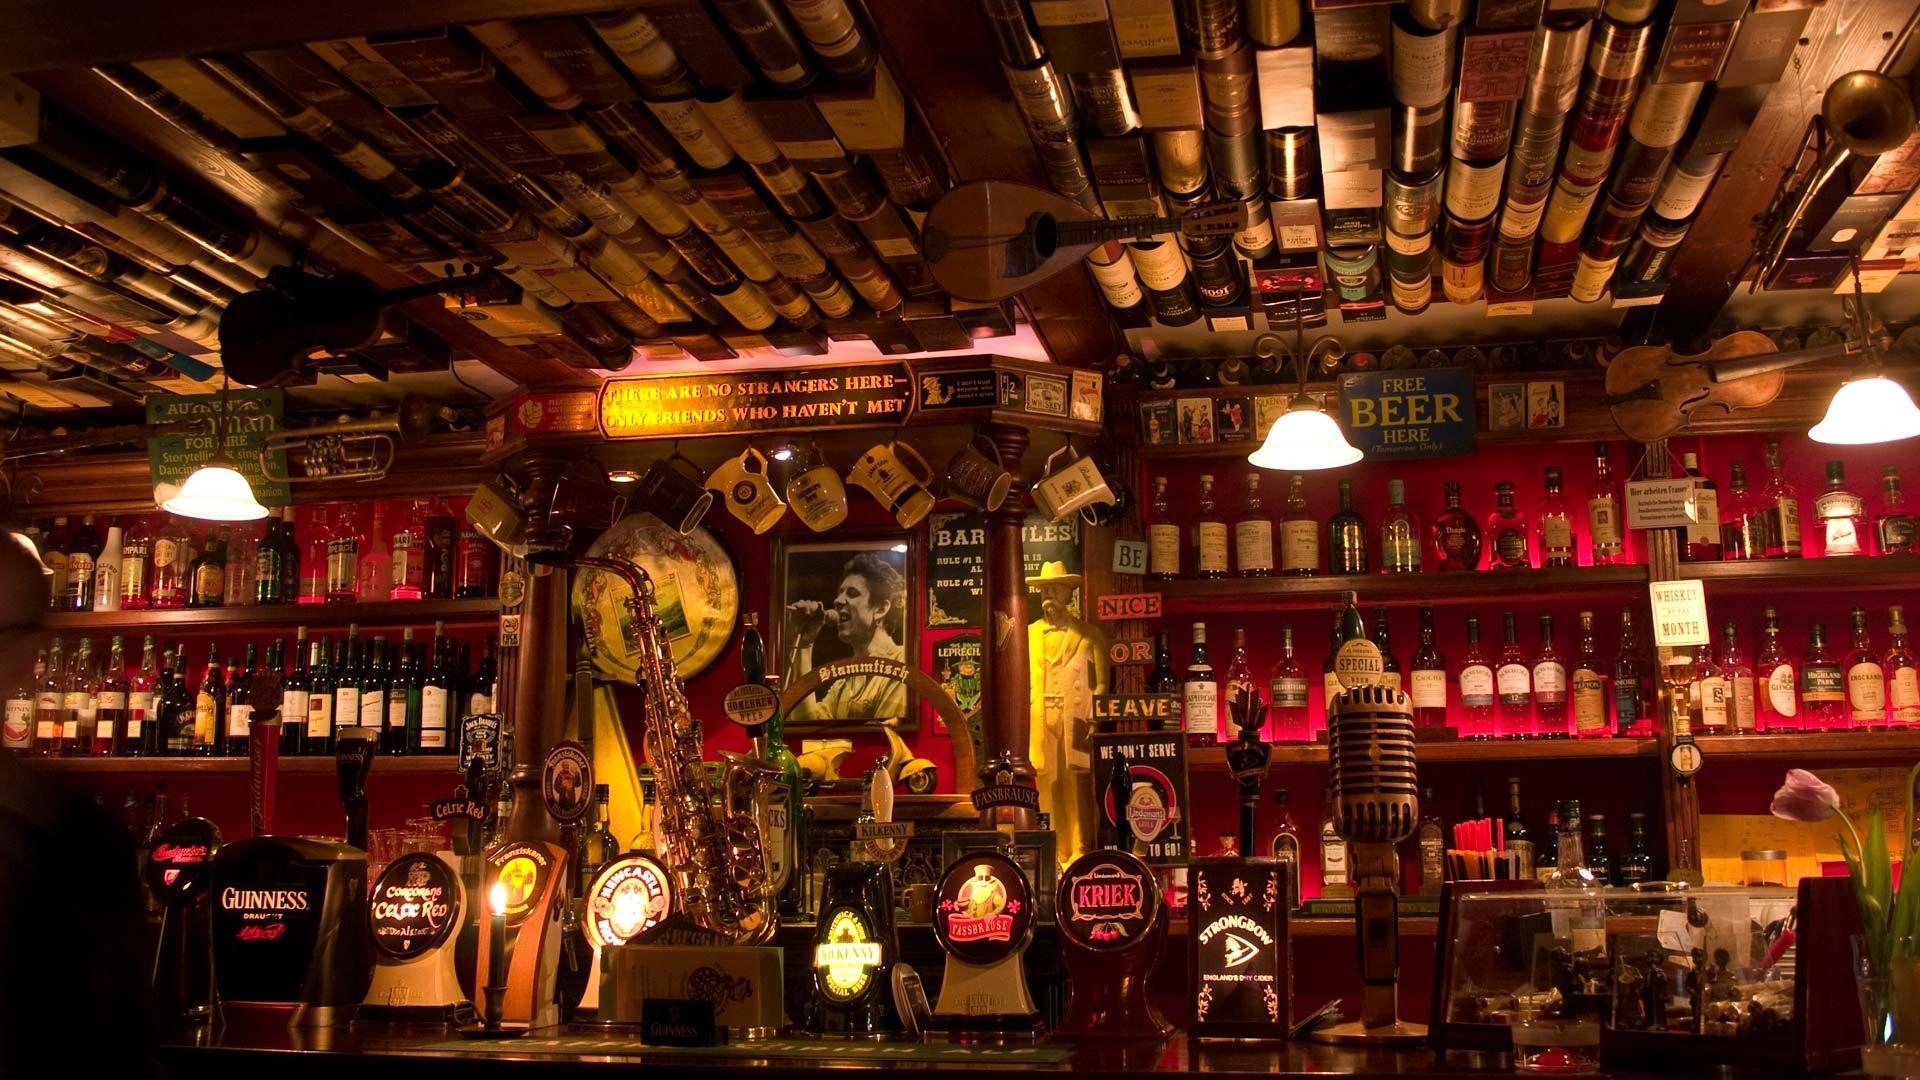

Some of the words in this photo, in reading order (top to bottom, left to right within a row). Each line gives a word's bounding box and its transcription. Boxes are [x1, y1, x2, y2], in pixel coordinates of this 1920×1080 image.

[605, 387, 661, 402] THERE
[667, 384, 703, 399] ARE
[708, 383, 732, 397] NO
[737, 377, 839, 396] STRANGERS
[1382, 377, 1427, 393] FREE
[605, 412, 648, 428] ONLY
[653, 408, 727, 426] FRIENDS
[733, 406, 777, 420] WHO
[782, 398, 858, 418] HAVEN'T
[867, 398, 906, 414] MET
[1350, 393, 1464, 428] BEER
[185, 436, 214, 450] FOR
[1383, 428, 1431, 444] HERE
[936, 528, 985, 547] BAR
[936, 555, 960, 565] RULE
[1118, 545, 1143, 569] BE
[936, 579, 961, 588] RULE
[1655, 589, 1697, 602] WHISKEY
[1102, 596, 1159, 617] NICE
[1662, 621, 1700, 636] MONTH
[938, 647, 981, 657] LEPRECH
[1110, 641, 1153, 663] OR
[819, 659, 910, 682] Stammtisch
[1339, 658, 1380, 672] SPECIAL
[727, 696, 773, 712] HOMEBREW
[1095, 699, 1170, 718] LEAVE
[1100, 745, 1114, 760] WE
[1117, 744, 1145, 759] DON'T
[1149, 743, 1177, 758] SERVE
[974, 786, 1038, 808] FASSBRAUSE
[861, 823, 908, 837] KILKENNY
[495, 846, 547, 867] Franziskaner
[1149, 844, 1161, 857] TO
[1164, 843, 1181, 857] GO!
[600, 866, 661, 899] NEWCASTLE
[222, 886, 308, 911] GUINNESS
[1078, 884, 1137, 908] KRIEK
[952, 919, 1008, 937] FASSBRAUSE
[1199, 914, 1274, 945] STRONGBOW
[1203, 974, 1239, 982] ENGLAND'S
[1239, 974, 1253, 982] DRY
